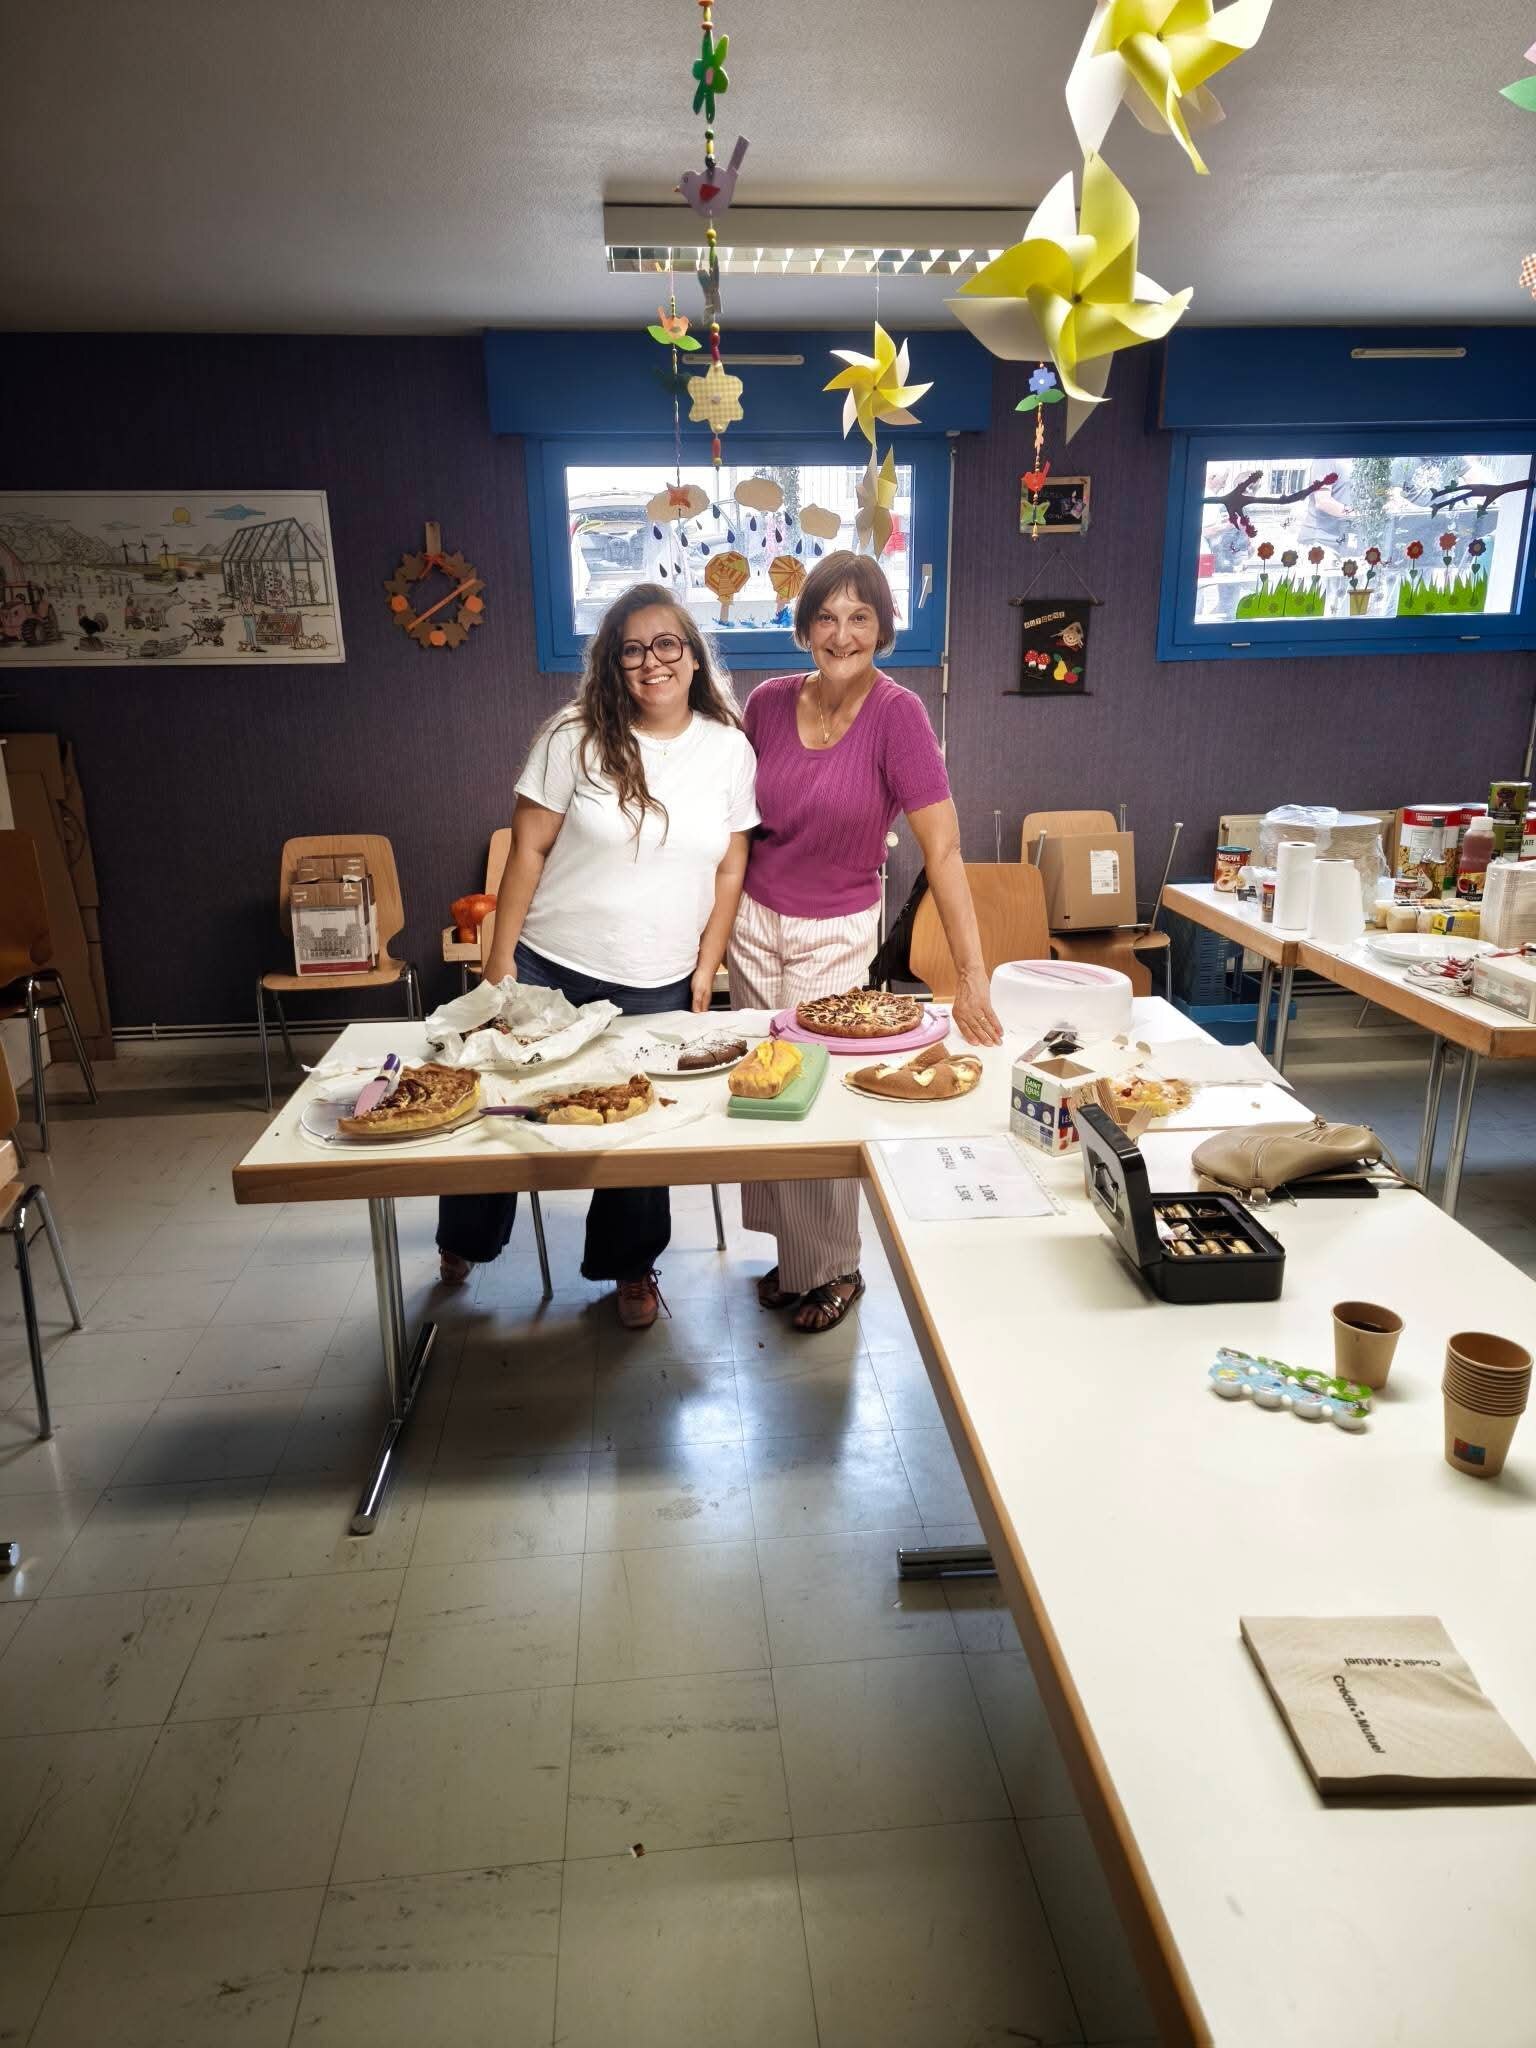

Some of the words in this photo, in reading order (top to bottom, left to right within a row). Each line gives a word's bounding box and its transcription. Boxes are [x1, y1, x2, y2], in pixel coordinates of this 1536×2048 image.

[1024, 611, 1065, 629] AUTOMNE
[1025, 1085, 1041, 1097] LOUIS
[1026, 1077, 1042, 1091] SAINT
[1344, 1658, 1388, 1666] Mutuel
[1333, 1675, 1357, 1707] Crédit
[1357, 1719, 1386, 1754] Mutuel
